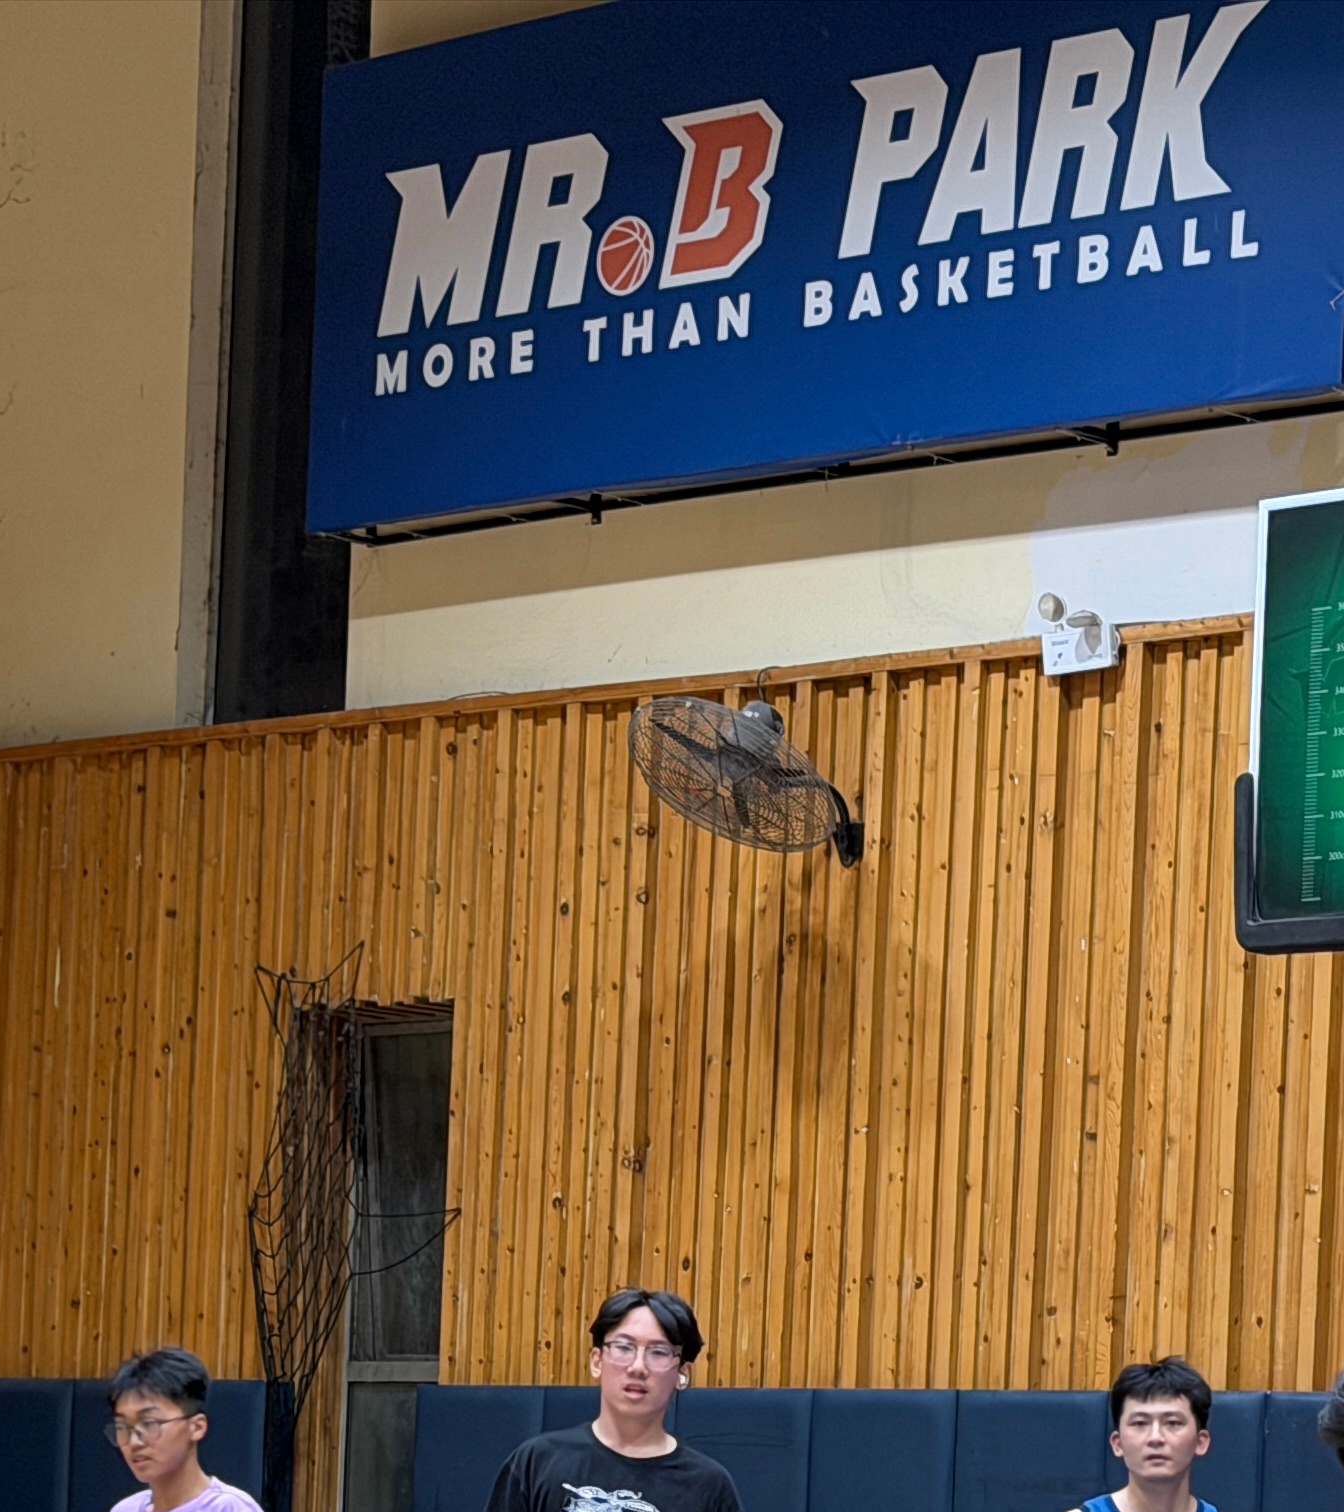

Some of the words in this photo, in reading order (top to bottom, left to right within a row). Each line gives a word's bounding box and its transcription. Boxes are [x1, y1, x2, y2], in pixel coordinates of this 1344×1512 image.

[837, 0, 1269, 260] PARK
[374, 328, 535, 397] MORE
[582, 292, 751, 363] THAN
[802, 208, 1259, 328] BASKETBALL
